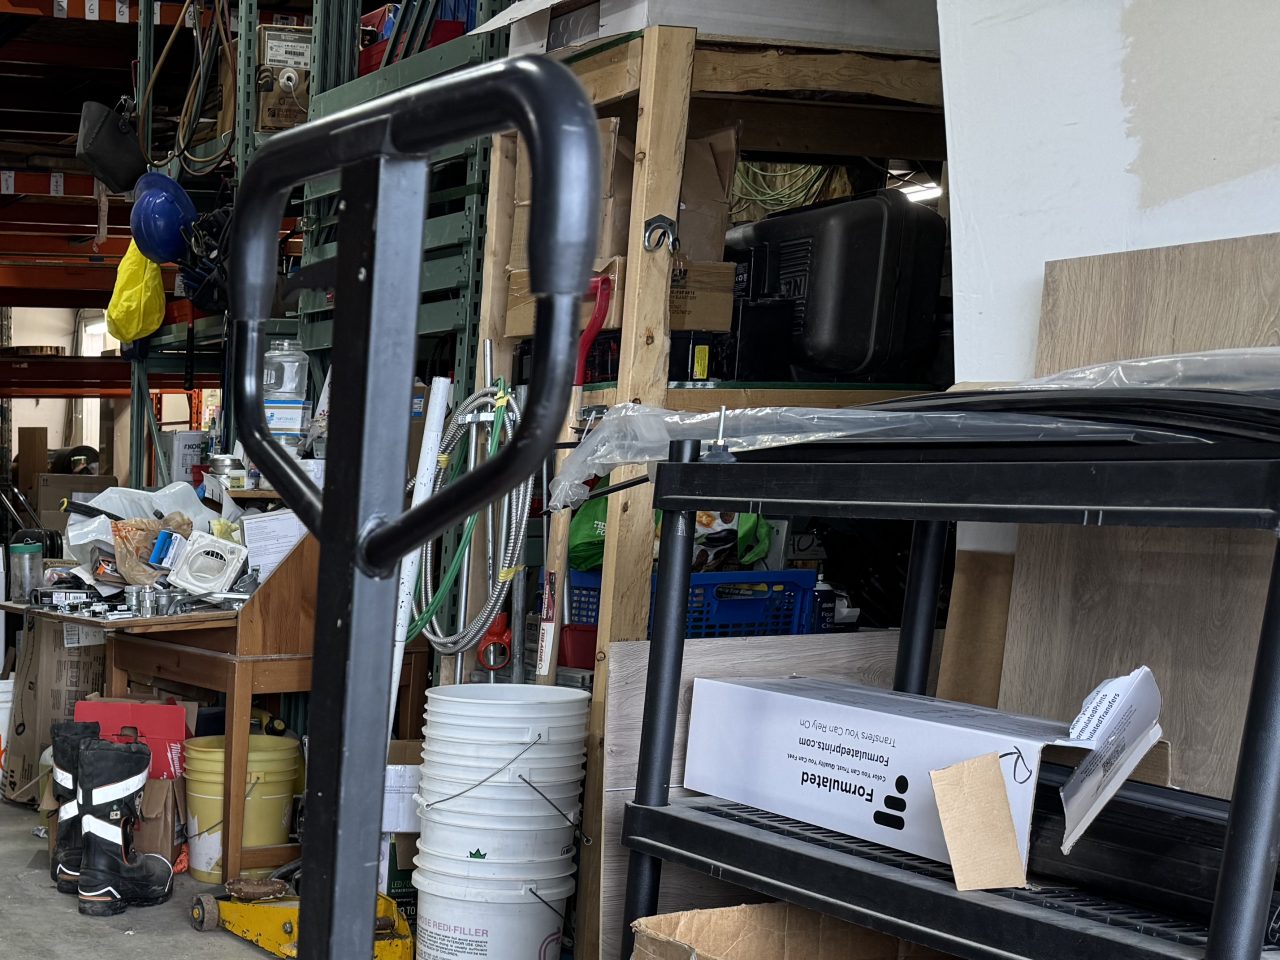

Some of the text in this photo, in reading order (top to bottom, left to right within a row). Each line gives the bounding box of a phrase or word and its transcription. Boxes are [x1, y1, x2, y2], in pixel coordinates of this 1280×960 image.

[1076, 694, 1108, 740] ormulatedPrints
[800, 718, 896, 748] Transfers You Can Rely On
[798, 736, 890, 766] Formulatedprints.com
[798, 755, 808, 763] Can
[818, 760, 835, 770] Quality
[836, 764, 850, 774] Trust,
[850, 768, 860, 776] Can
[872, 772, 886, 782] Color
[800, 771, 874, 802] Formulated
